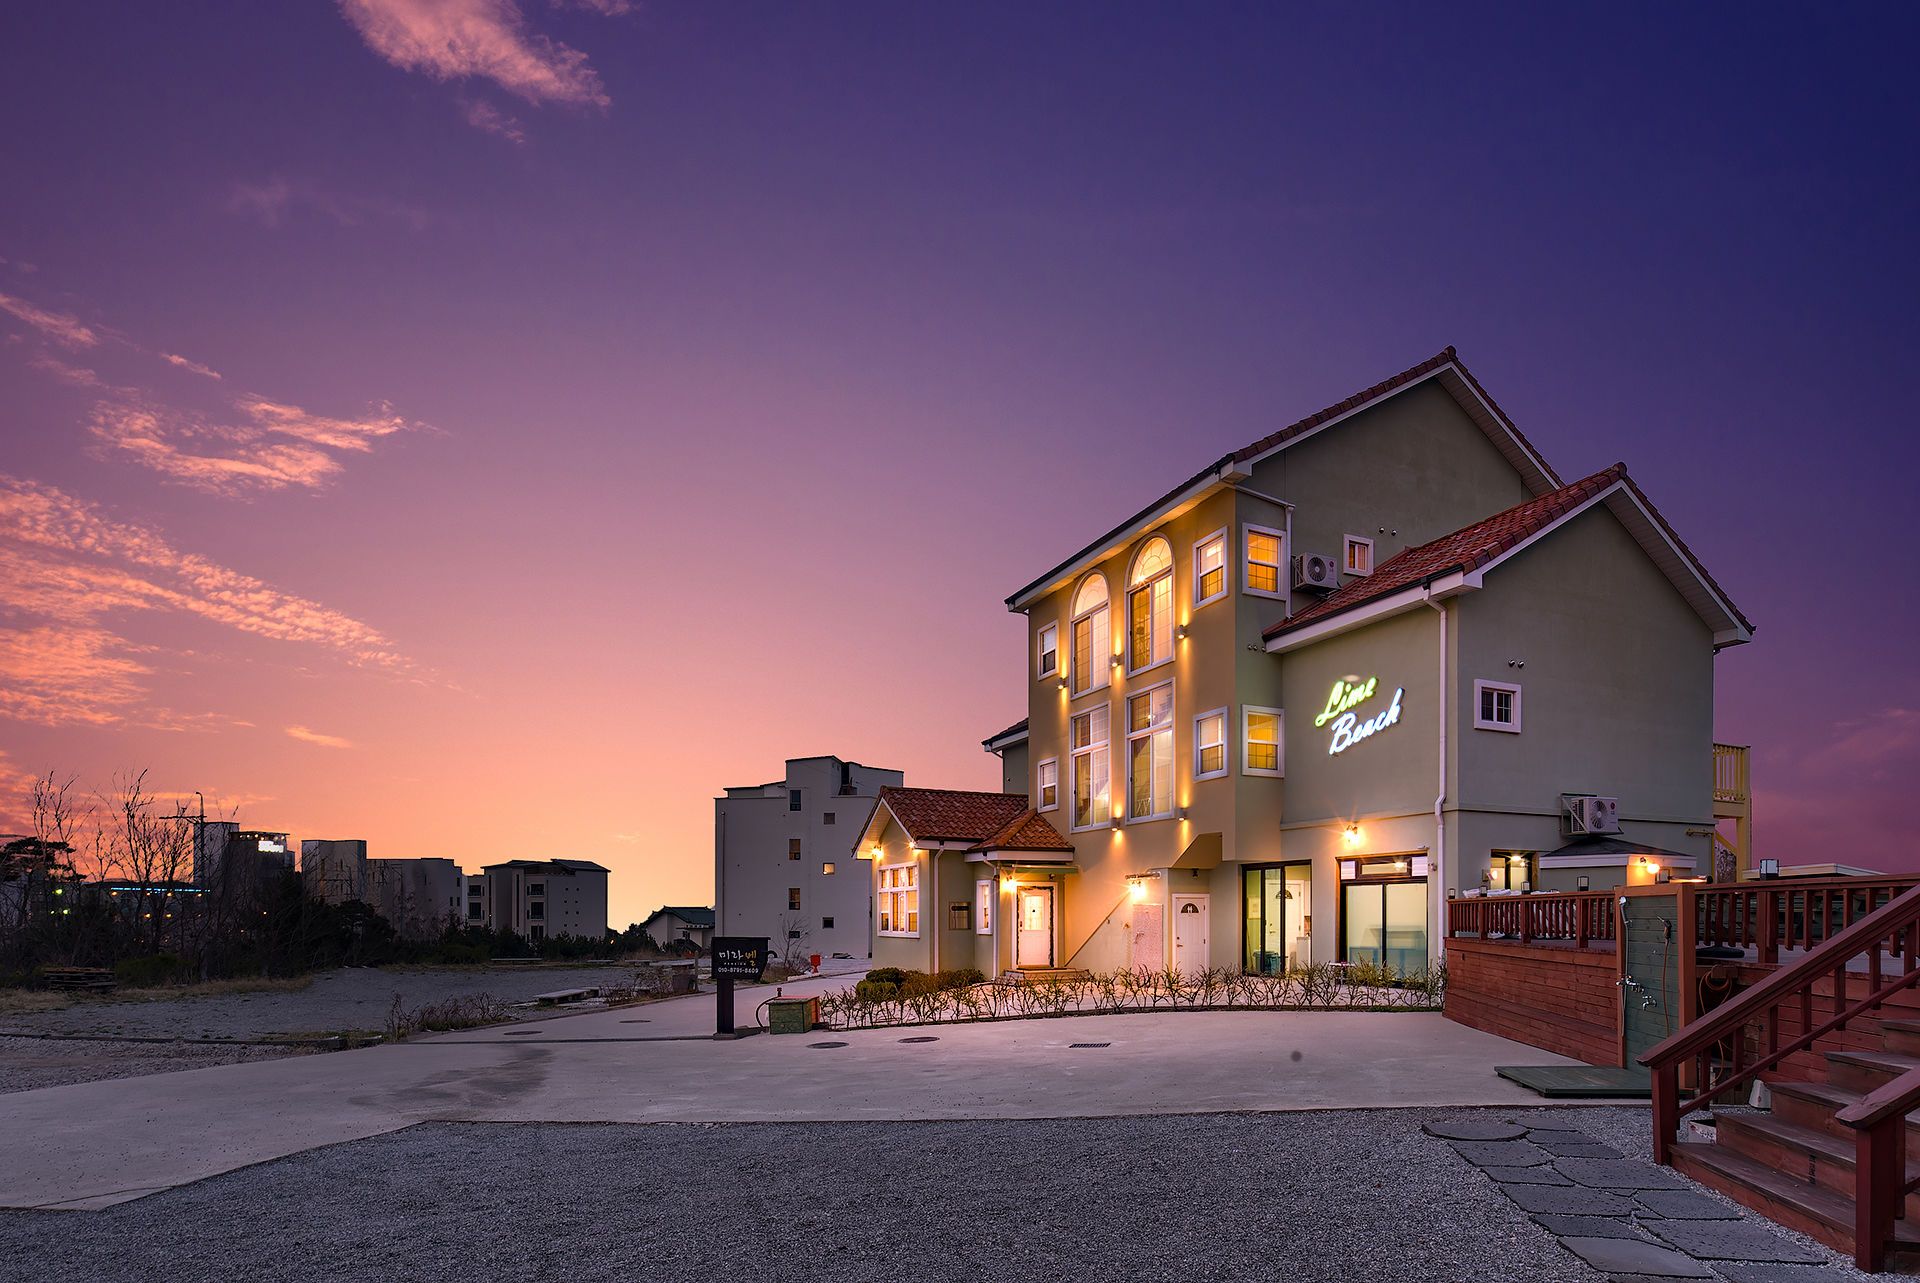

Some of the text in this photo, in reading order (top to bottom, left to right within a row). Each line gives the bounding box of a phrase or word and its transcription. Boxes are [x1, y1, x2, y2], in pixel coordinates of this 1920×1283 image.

[1315, 676, 1377, 727] Lime
[1329, 687, 1403, 755] Beach
[719, 950, 757, 967] 미라벨
